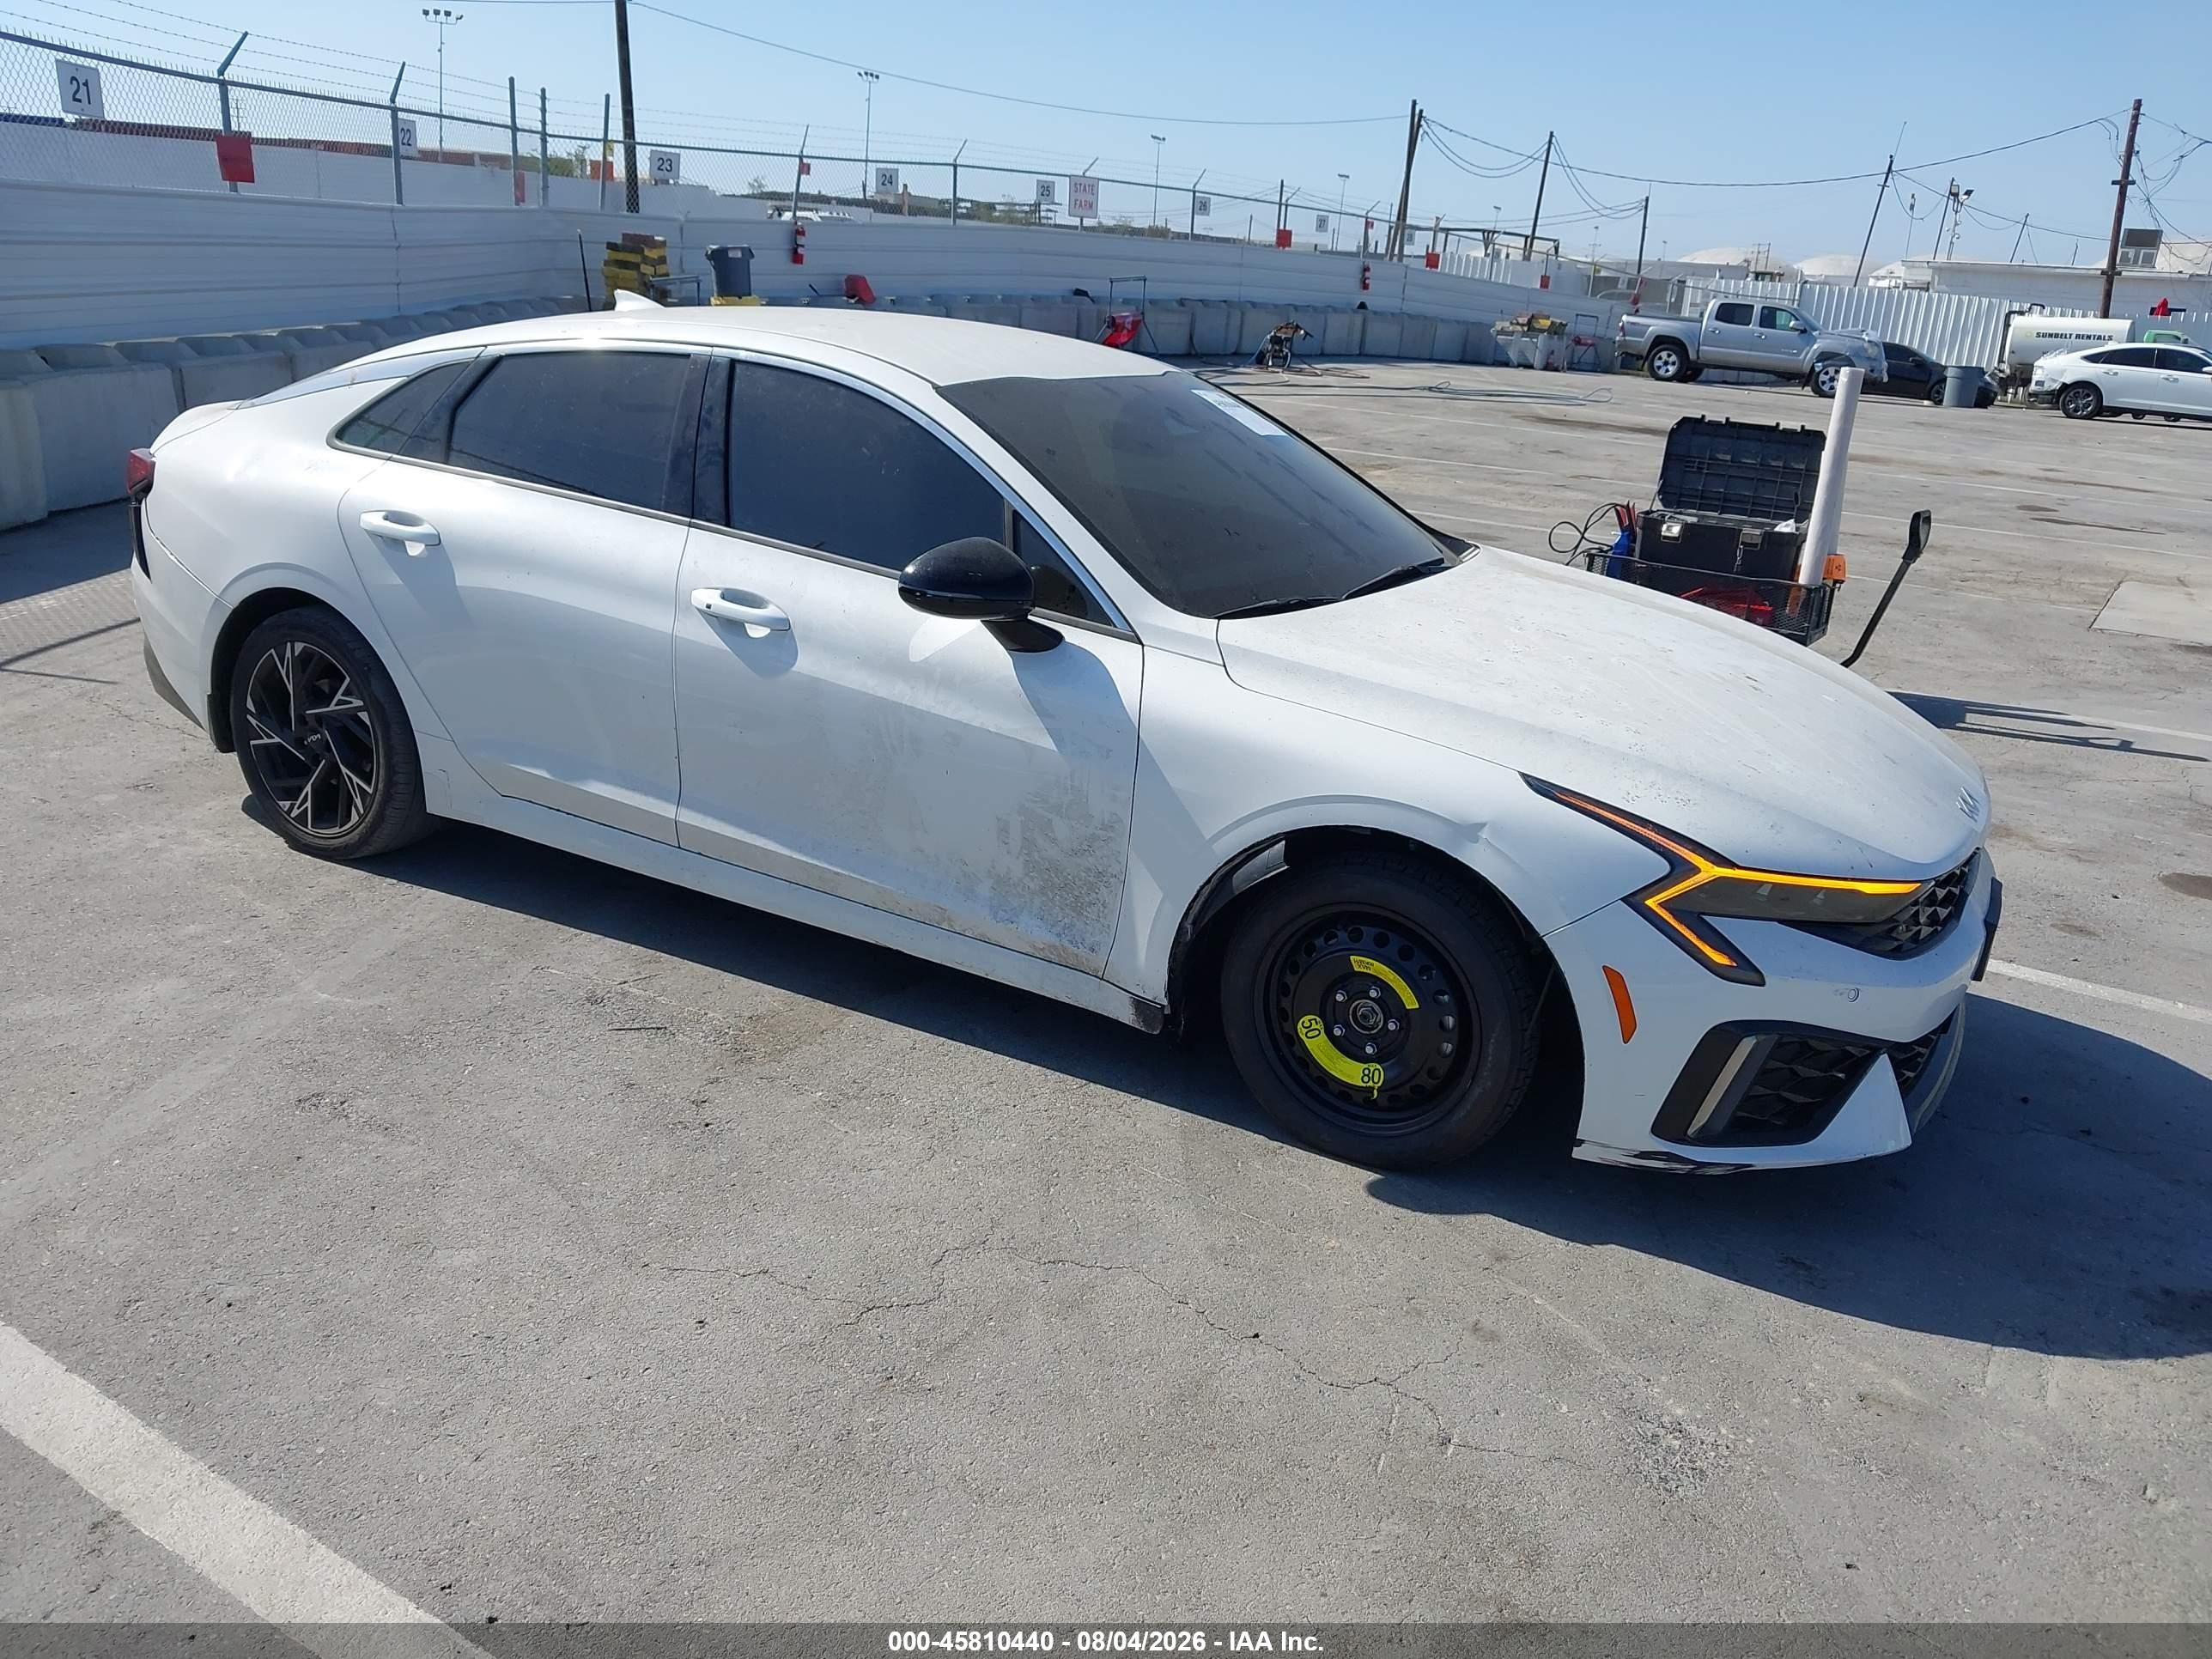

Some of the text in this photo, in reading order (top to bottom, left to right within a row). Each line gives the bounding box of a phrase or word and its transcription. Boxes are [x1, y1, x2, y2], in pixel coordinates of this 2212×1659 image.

[70, 76, 91, 105] 21
[399, 127, 412, 147] 22
[657, 157, 673, 172] 23
[881, 174, 894, 187] 24
[1040, 185, 1051, 197] 25
[1074, 182, 1095, 195] STATE
[1073, 199, 1094, 210] FARM
[2035, 331, 2073, 340] SUNBELT
[1301, 1018, 1322, 1039] 50
[1361, 1067, 1381, 1085] 80
